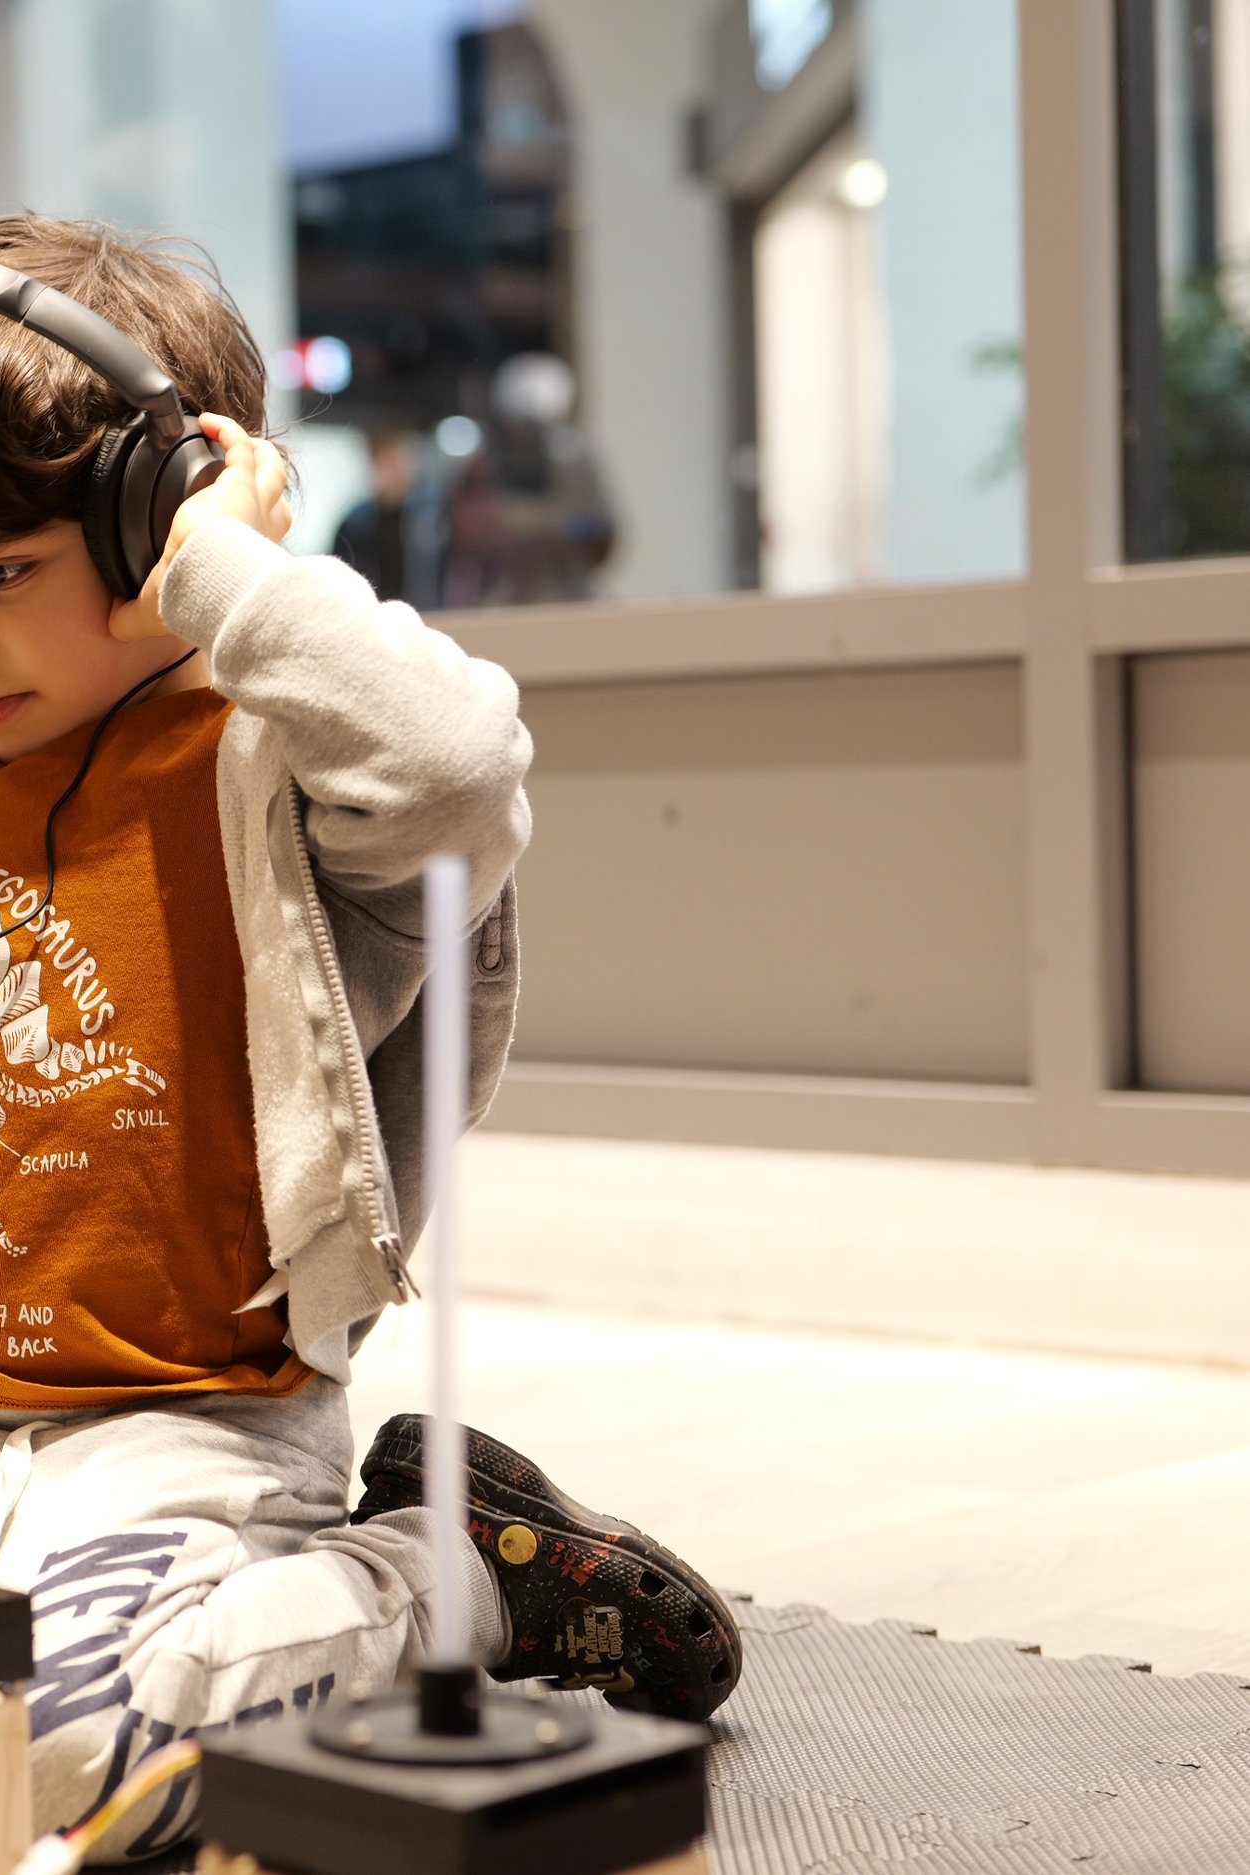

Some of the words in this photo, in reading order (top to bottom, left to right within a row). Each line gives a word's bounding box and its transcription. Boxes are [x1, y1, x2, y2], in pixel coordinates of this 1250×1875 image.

[111, 1108, 170, 1131] SKULL
[19, 1150, 89, 1175] SCAPULA
[18, 1302, 54, 1326] AND
[7, 1335, 58, 1359] BACK
